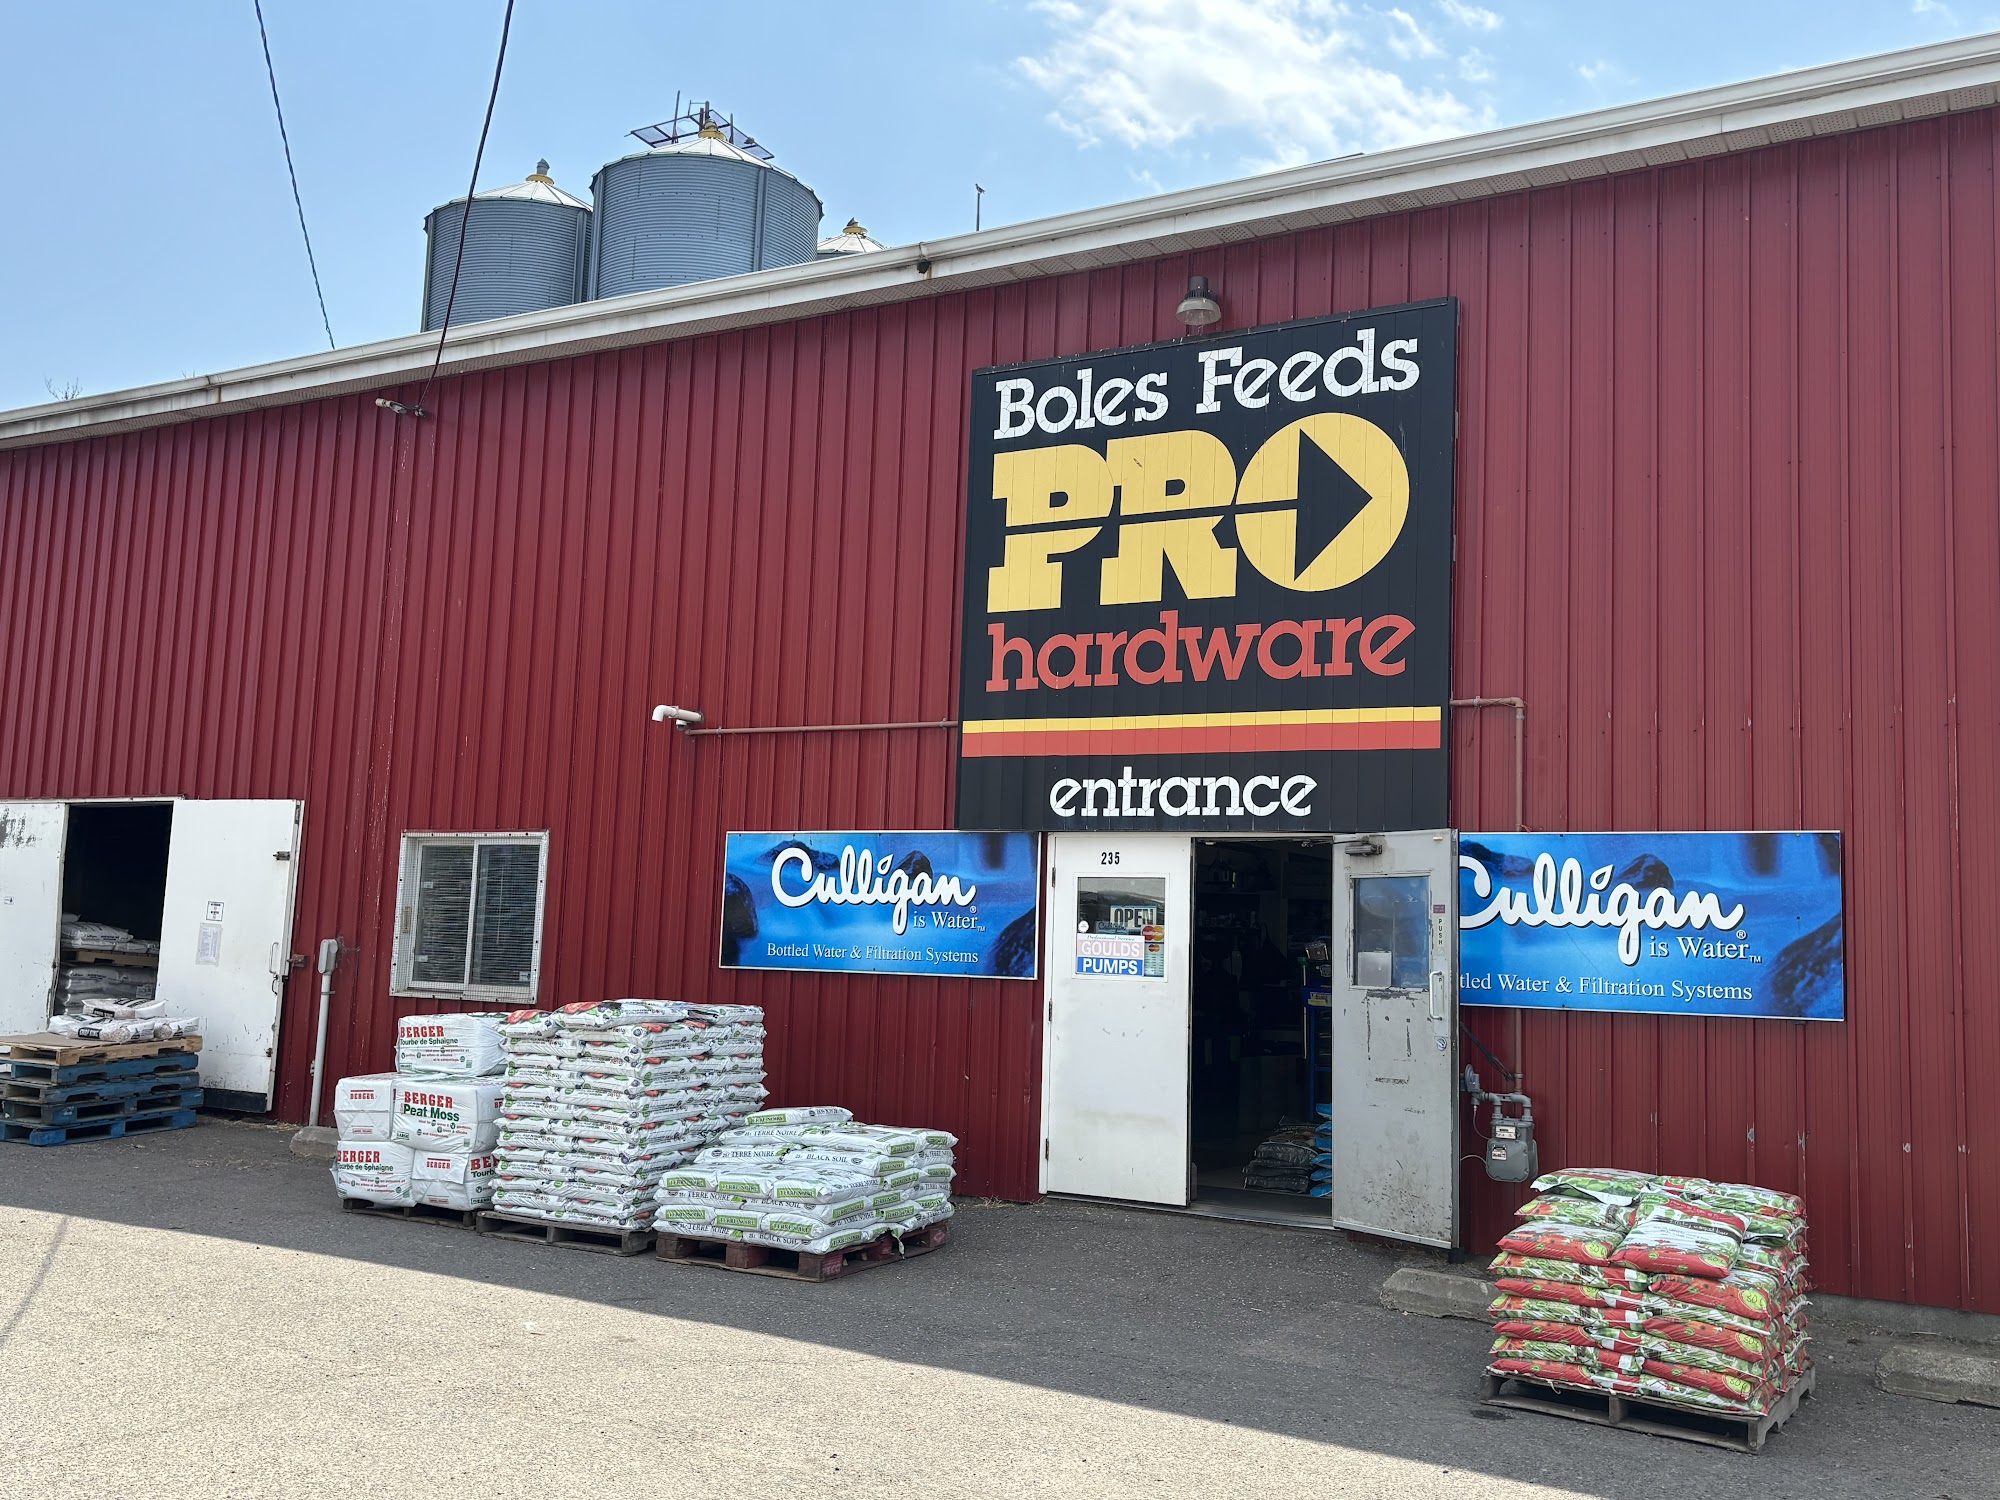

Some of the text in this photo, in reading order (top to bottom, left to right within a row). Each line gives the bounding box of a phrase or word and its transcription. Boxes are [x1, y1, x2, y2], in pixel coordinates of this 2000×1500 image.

[993, 327, 1421, 441] Boles Feeds
[986, 412, 1411, 613] PRO
[986, 609, 1416, 693] hardware
[1049, 766, 1318, 818] entrance
[1101, 851, 1120, 865] 235
[913, 911, 926, 928] is
[1113, 908, 1154, 928] OPEN
[767, 943, 979, 964] Bottled Water & Filtration Systems
[1081, 941, 1140, 957] GOULDS
[1649, 935, 1669, 957] is
[1082, 958, 1138, 975] PUMPS
[1460, 972, 1492, 990] tled
[1498, 973, 1548, 993] Water
[1555, 976, 1573, 993] &
[1578, 976, 1665, 997] Filtration
[1671, 980, 1753, 1002] Systems
[400, 1026, 445, 1038] BERGER
[404, 1091, 453, 1109] BERGER
[403, 1103, 428, 1118] Peat
[430, 1107, 460, 1122] Moss
[337, 1150, 380, 1163] BERGER
[426, 1161, 451, 1169] BERGER
[470, 1169, 497, 1178] Tourb
[688, 1191, 708, 1199] TERRE
[710, 1193, 730, 1201] NOIRE
[785, 1201, 801, 1209] SOIL
[688, 1223, 709, 1231] TERRE
